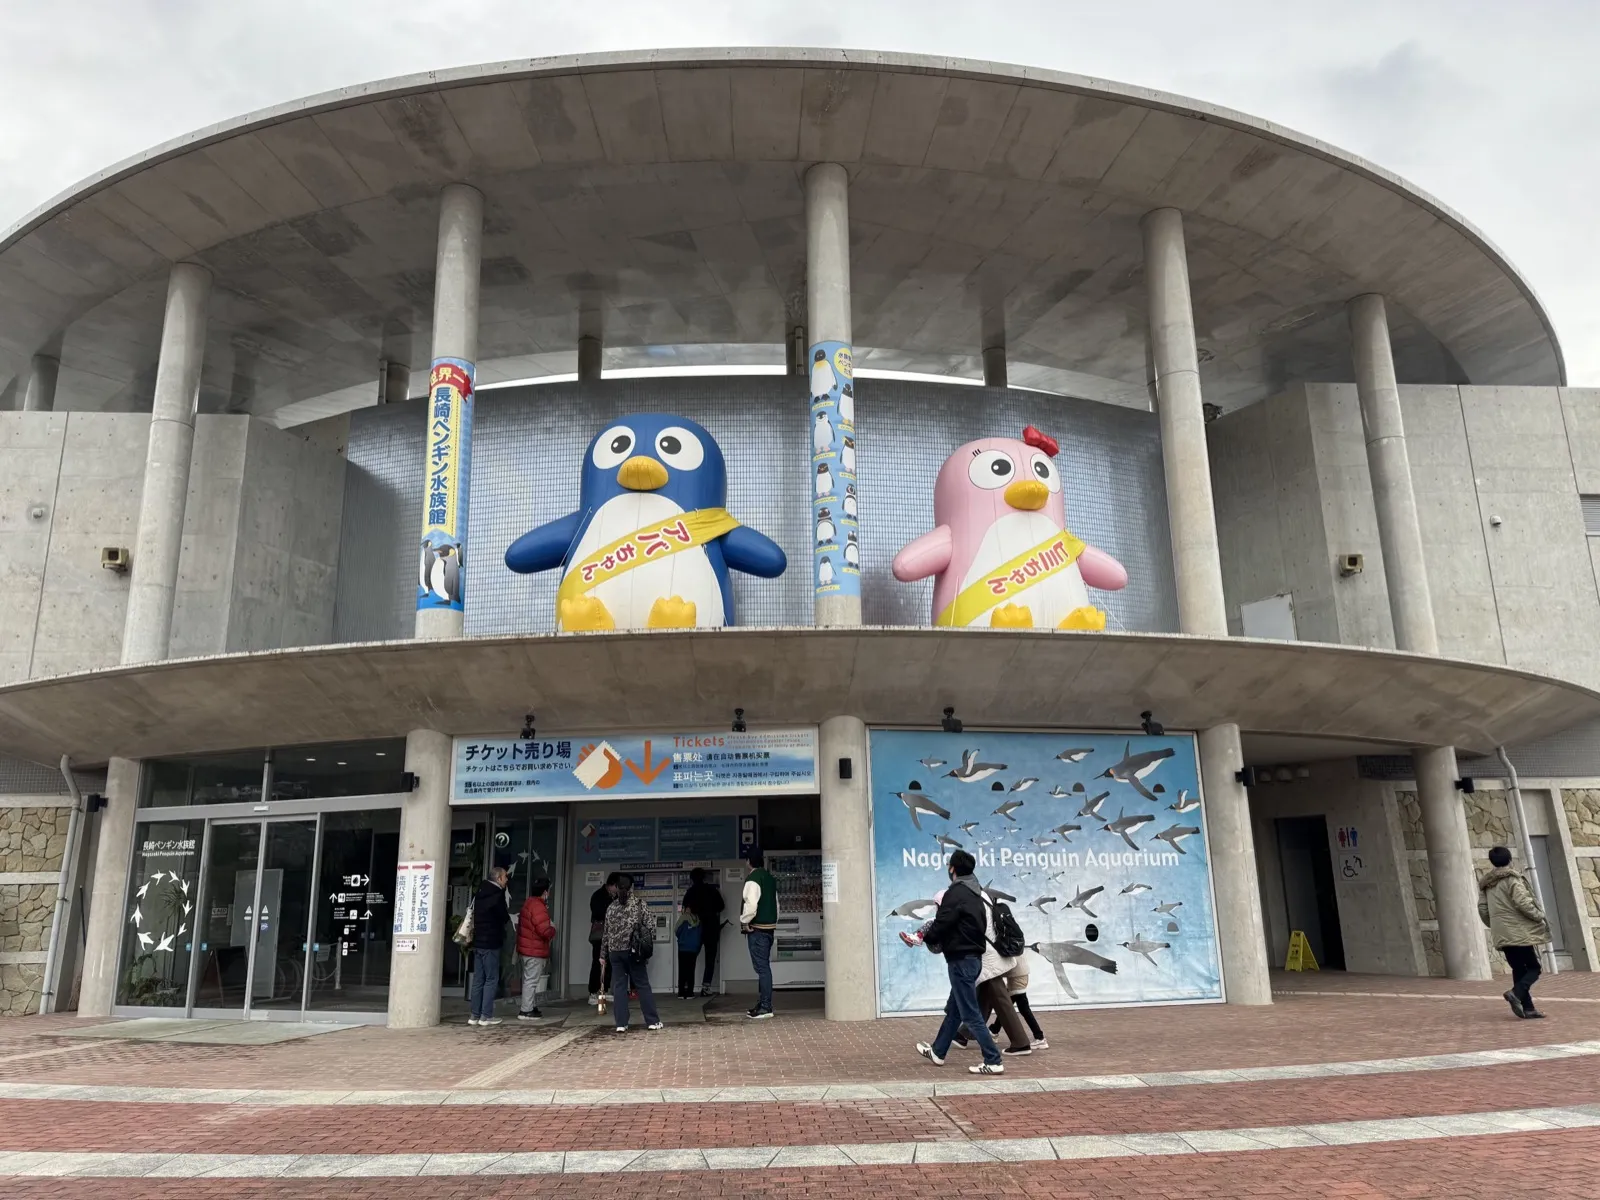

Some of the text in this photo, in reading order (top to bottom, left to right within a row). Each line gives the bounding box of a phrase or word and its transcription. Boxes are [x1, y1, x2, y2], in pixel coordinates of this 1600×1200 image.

[430, 367, 465, 387] 世界一
[428, 387, 452, 525] 長崎ペンギン水族館
[582, 521, 690, 581] アバちゃん
[465, 741, 571, 761] チケット売り場
[673, 736, 725, 748] Tickets
[466, 763, 574, 772] チケットはこちらでお買い求め下さい。
[673, 752, 702, 763] 售票处
[673, 771, 714, 782] 표파는곳
[143, 839, 196, 851] 長崎ペンギン水族館
[903, 848, 1179, 870] Nagaki Penguin Aquarium
[416, 875, 429, 932] チケット売り場
